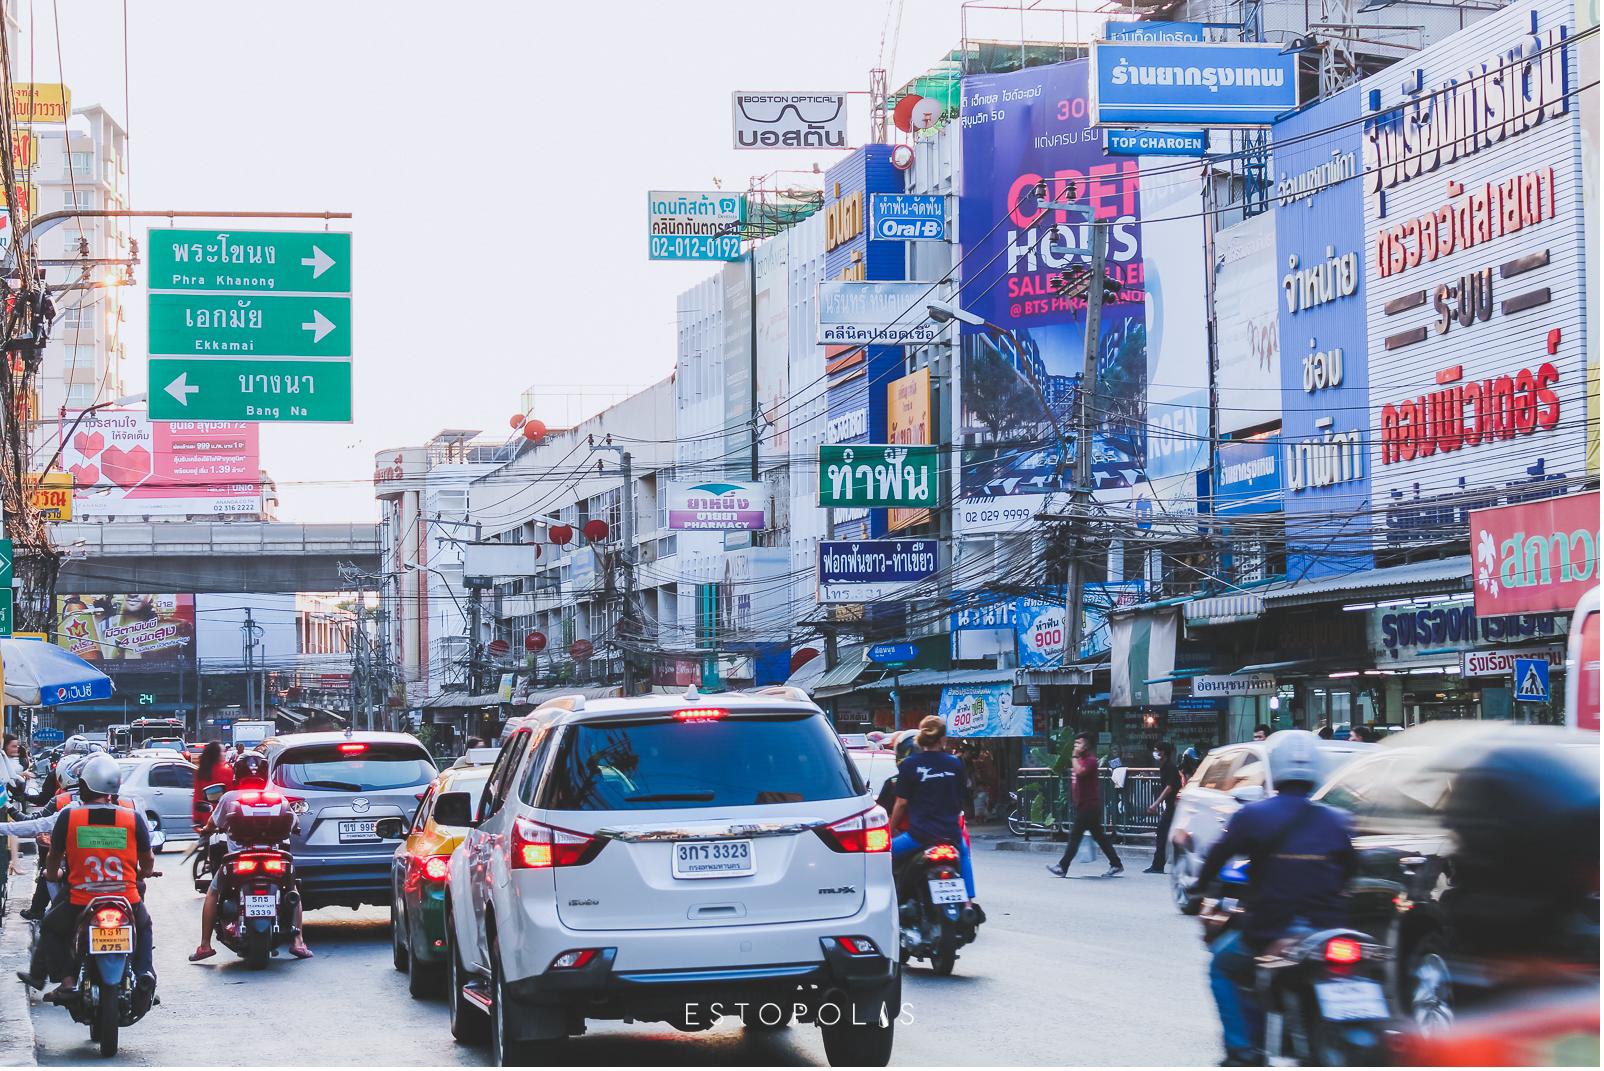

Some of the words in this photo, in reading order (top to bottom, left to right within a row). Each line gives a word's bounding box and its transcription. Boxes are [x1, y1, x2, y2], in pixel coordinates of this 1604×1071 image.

[1112, 57, 1284, 93] ร้านยากรุงเทพ
[992, 110, 1005, 121] 50
[738, 124, 845, 147] บอสตัน
[1112, 138, 1138, 148] TOP
[1140, 138, 1201, 149] CHAROEN
[653, 195, 716, 215] เดนทิสต้า
[880, 197, 942, 216] ทำฟัน-จัดฟัน
[882, 220, 938, 236] Oral-B
[1375, 166, 1556, 279] ตรวจวัดสายตา
[172, 234, 276, 264] พระโขนง
[653, 238, 739, 257] 02-012-0192
[172, 275, 205, 285] Phra
[216, 275, 275, 288] Khanong
[1283, 245, 1358, 313] จำหน่าย
[1025, 300, 1048, 316] BTS
[1434, 266, 1493, 335] ระบบ
[186, 300, 262, 328] เอกมัย
[195, 340, 254, 350] Ekkamai
[1302, 338, 1343, 393] ซ่อม
[239, 374, 314, 394] บางนา
[1381, 328, 1561, 465] คอมพิวเตอร์
[246, 406, 279, 417] Bang
[290, 407, 307, 417] Na
[196, 442, 210, 450] 999
[1286, 416, 1363, 493] นาฬิกา
[210, 465, 230, 473] 1.39
[827, 448, 929, 501] ทำฟัน
[684, 521, 750, 529] PHARMACY
[965, 512, 978, 523] 02
[980, 510, 1000, 522] 029
[1003, 509, 1030, 521] 9999
[823, 542, 934, 574] ฟอกฟันขาว-ทำเขี้ยว
[1035, 618, 1059, 631] ทำฟัน
[1035, 629, 1061, 648] 900
[1197, 674, 1274, 695] อ่อนนุชนาฬิกา
[140, 694, 153, 704] 24
[953, 712, 971, 726] 900
[713, 843, 749, 859] 3323
[83, 856, 124, 883] 39
[100, 944, 122, 952] 475
